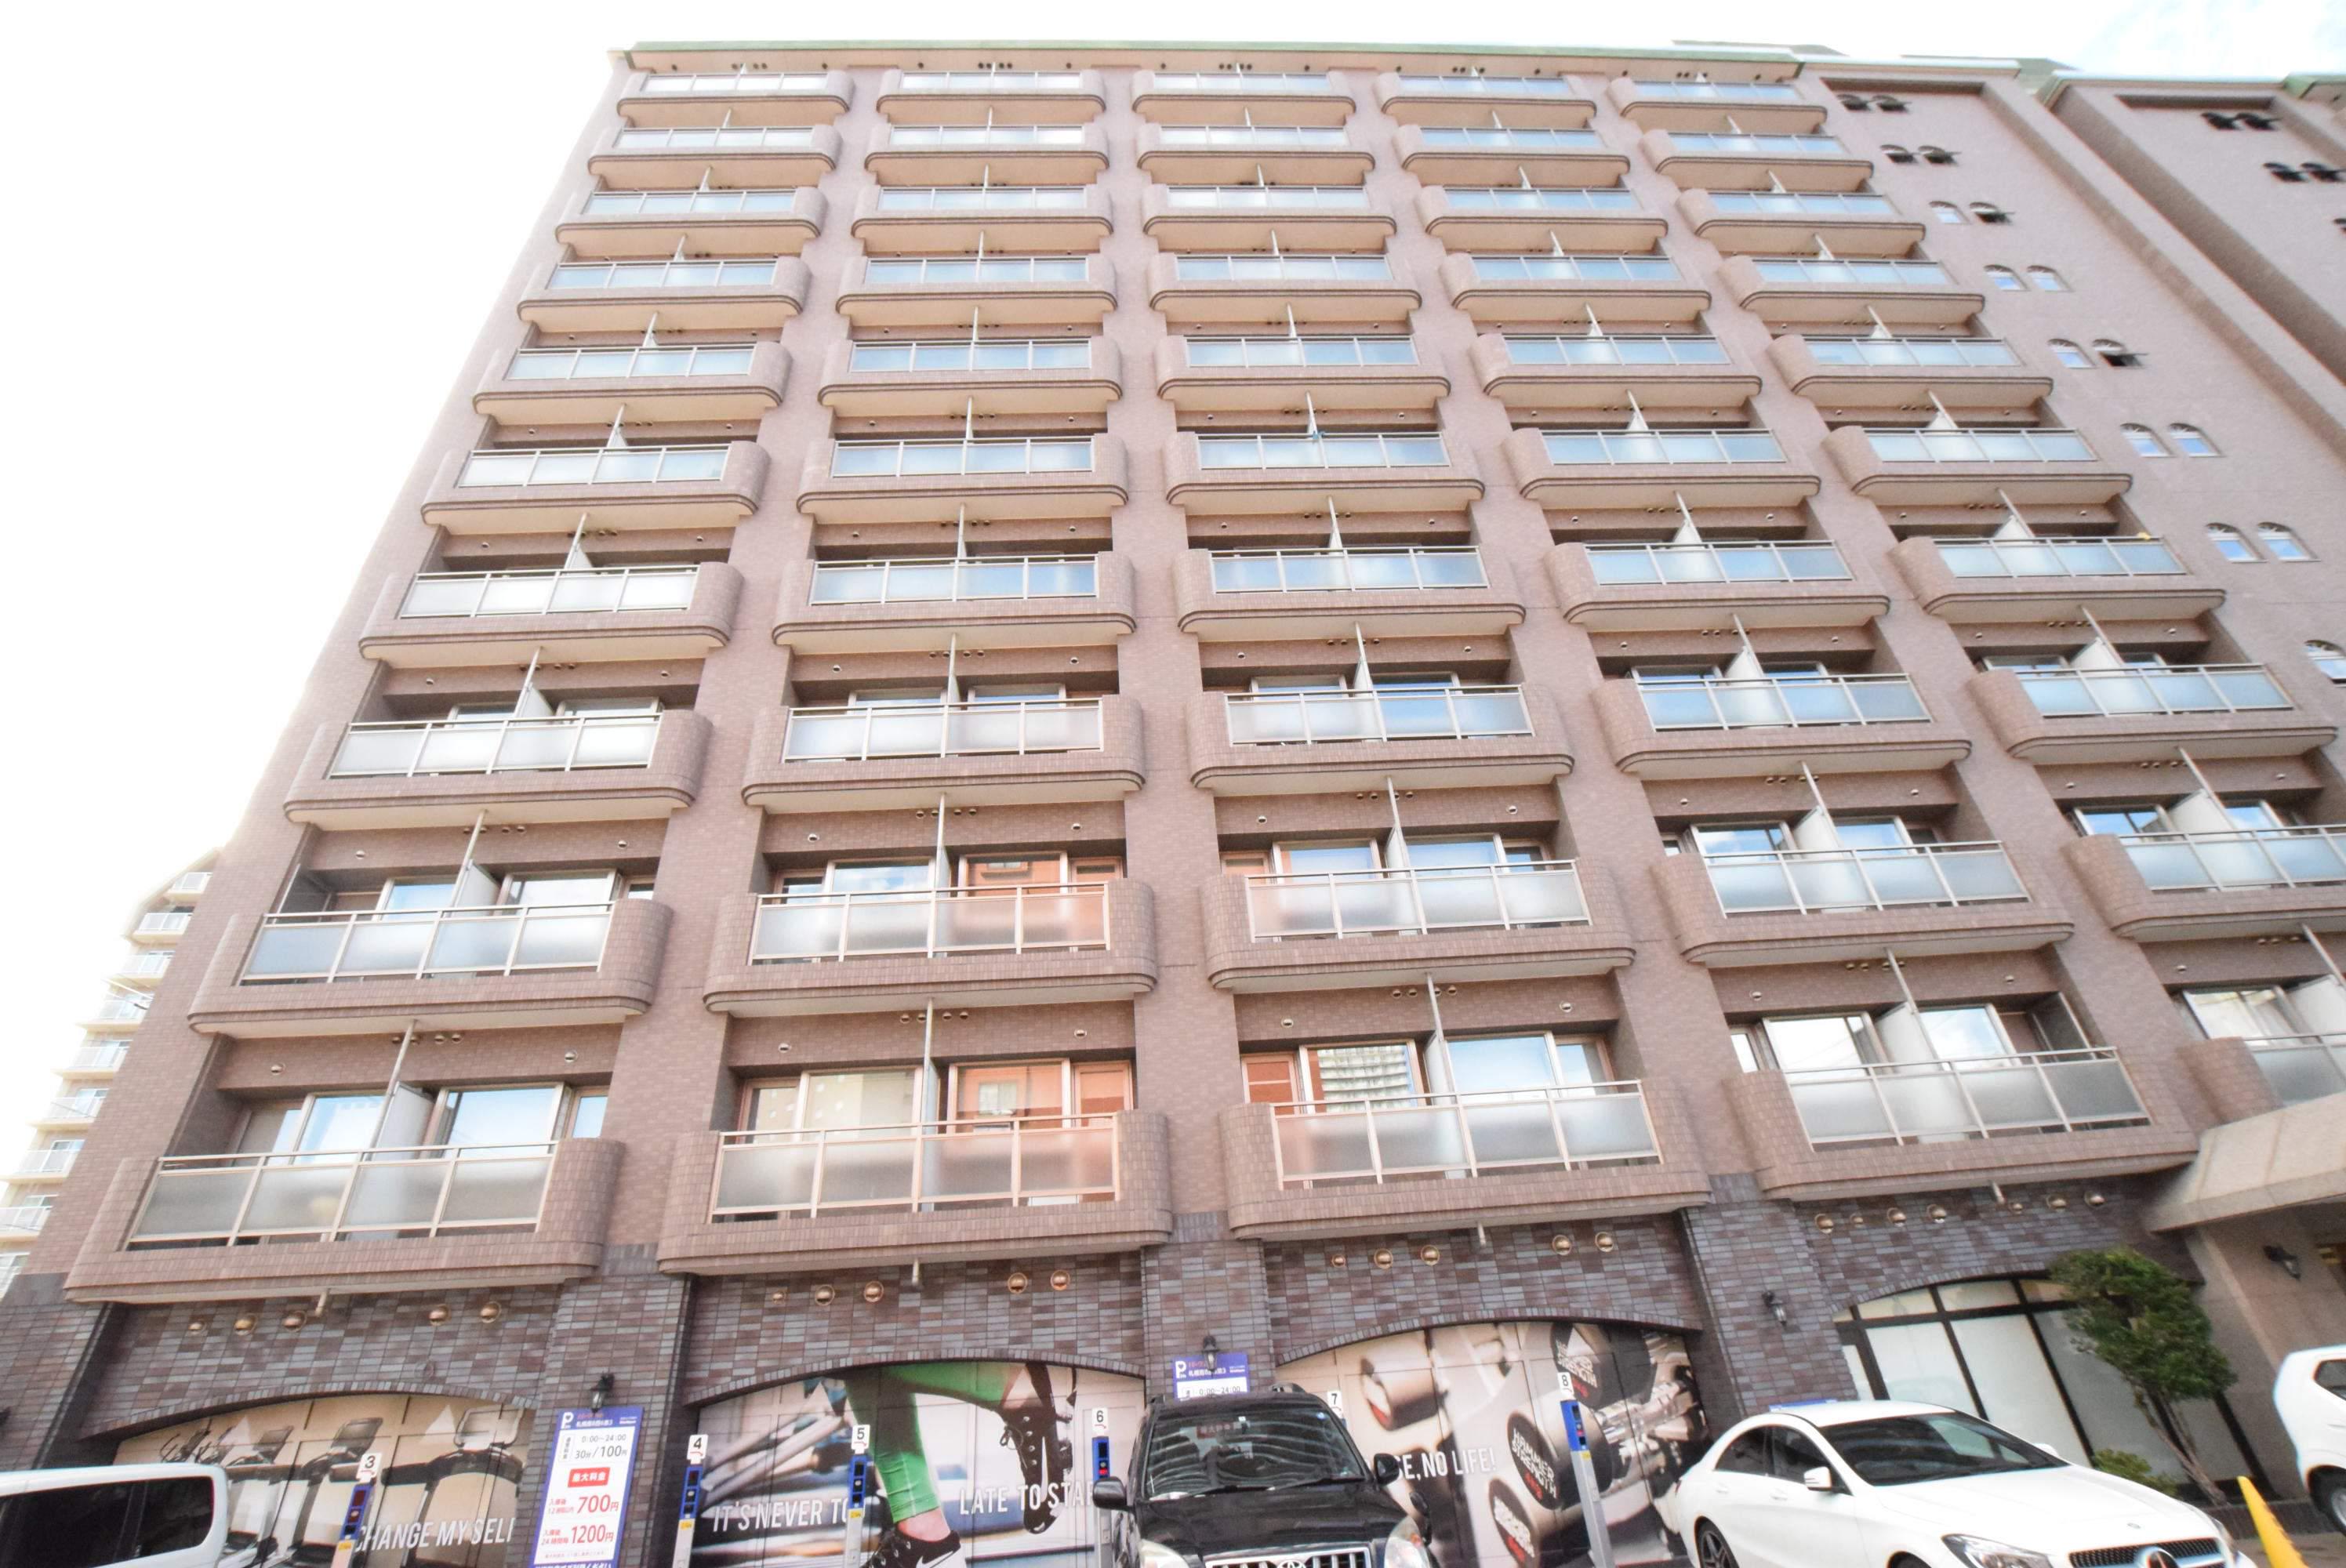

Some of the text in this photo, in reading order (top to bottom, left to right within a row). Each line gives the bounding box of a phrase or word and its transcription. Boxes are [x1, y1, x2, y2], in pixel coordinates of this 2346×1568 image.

[1562, 1374, 1569, 1387] 8
[1331, 1393, 1338, 1405] 7
[1096, 1410, 1104, 1423] 6
[857, 1427, 865, 1439] 5
[693, 1438, 703, 1450] 4
[365, 1455, 376, 1468] 3
[1422, 1451, 1447, 1478] NO
[1451, 1446, 1496, 1475] LIFE!
[577, 1494, 619, 1514] 700円
[960, 1485, 1008, 1515] LATE
[1018, 1484, 1040, 1510] TO
[714, 1501, 750, 1532] IT'S
[755, 1499, 823, 1529] NEVER
[436, 1520, 468, 1546] MY
[572, 1524, 614, 1544] 1200円
